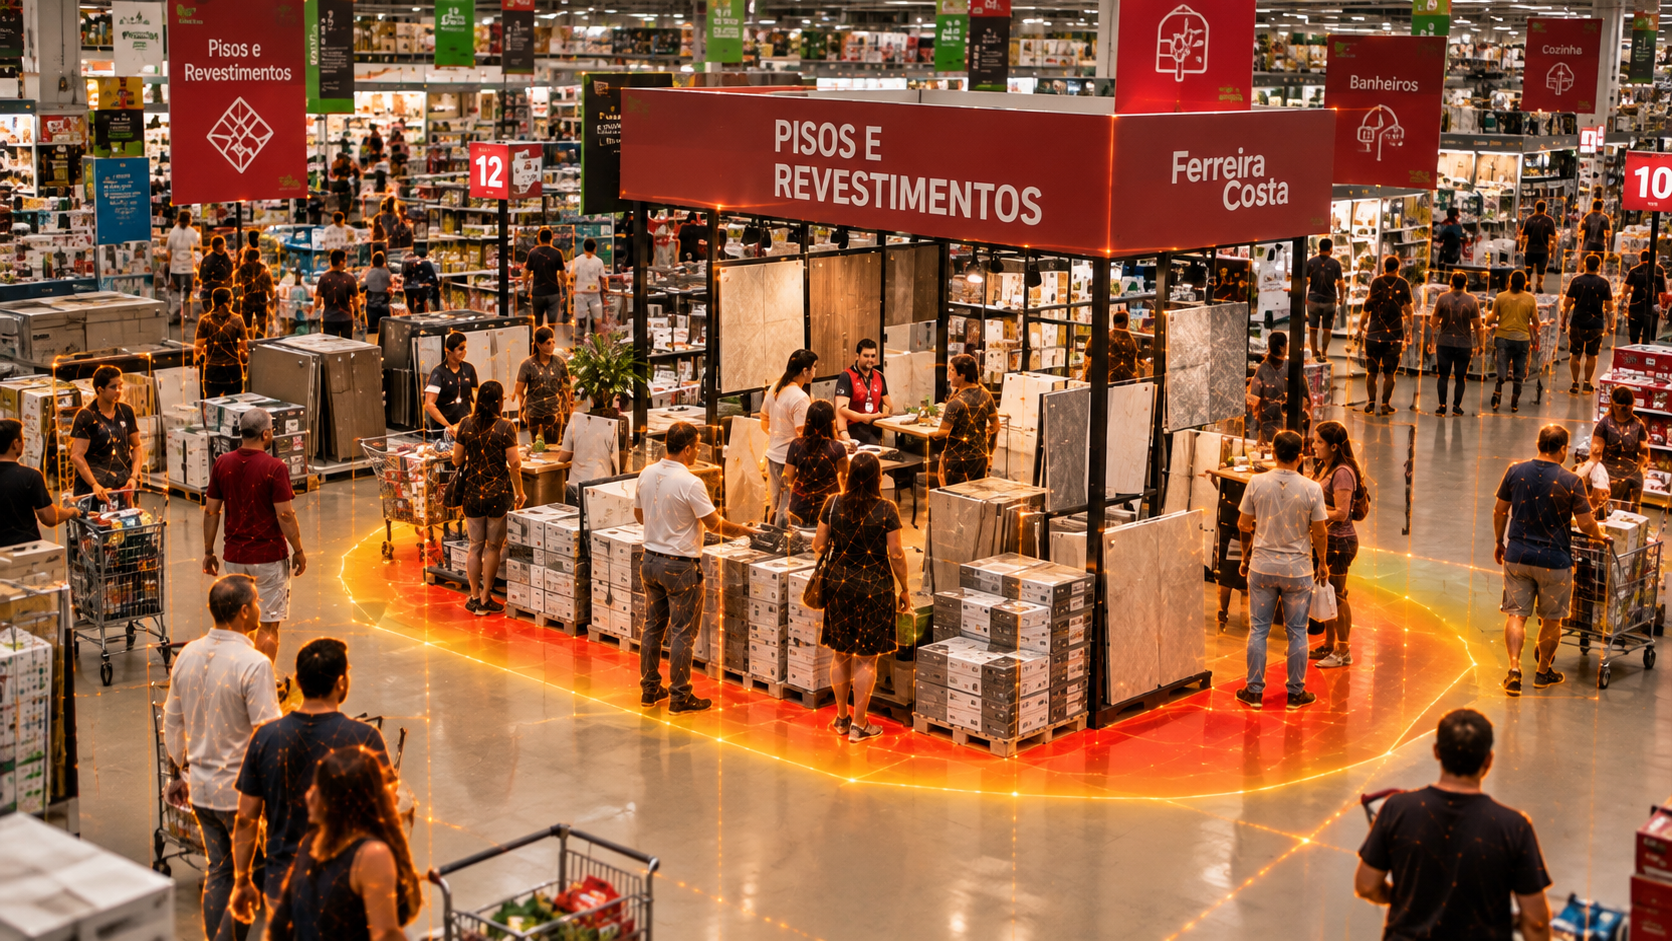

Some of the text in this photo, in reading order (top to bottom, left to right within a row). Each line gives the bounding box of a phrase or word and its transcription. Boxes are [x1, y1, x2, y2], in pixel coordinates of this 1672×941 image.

[208, 38, 261, 58] Pisos e
[184, 63, 292, 82] Revestimentos
[1349, 74, 1419, 92] Banheiros
[774, 119, 882, 161] PISOS E
[475, 154, 503, 189] 12
[1171, 147, 1265, 185] Ferreira
[1634, 165, 1672, 200] 10
[774, 163, 1042, 226] REVESTIMENTOS
[1223, 177, 1289, 211] Costa
